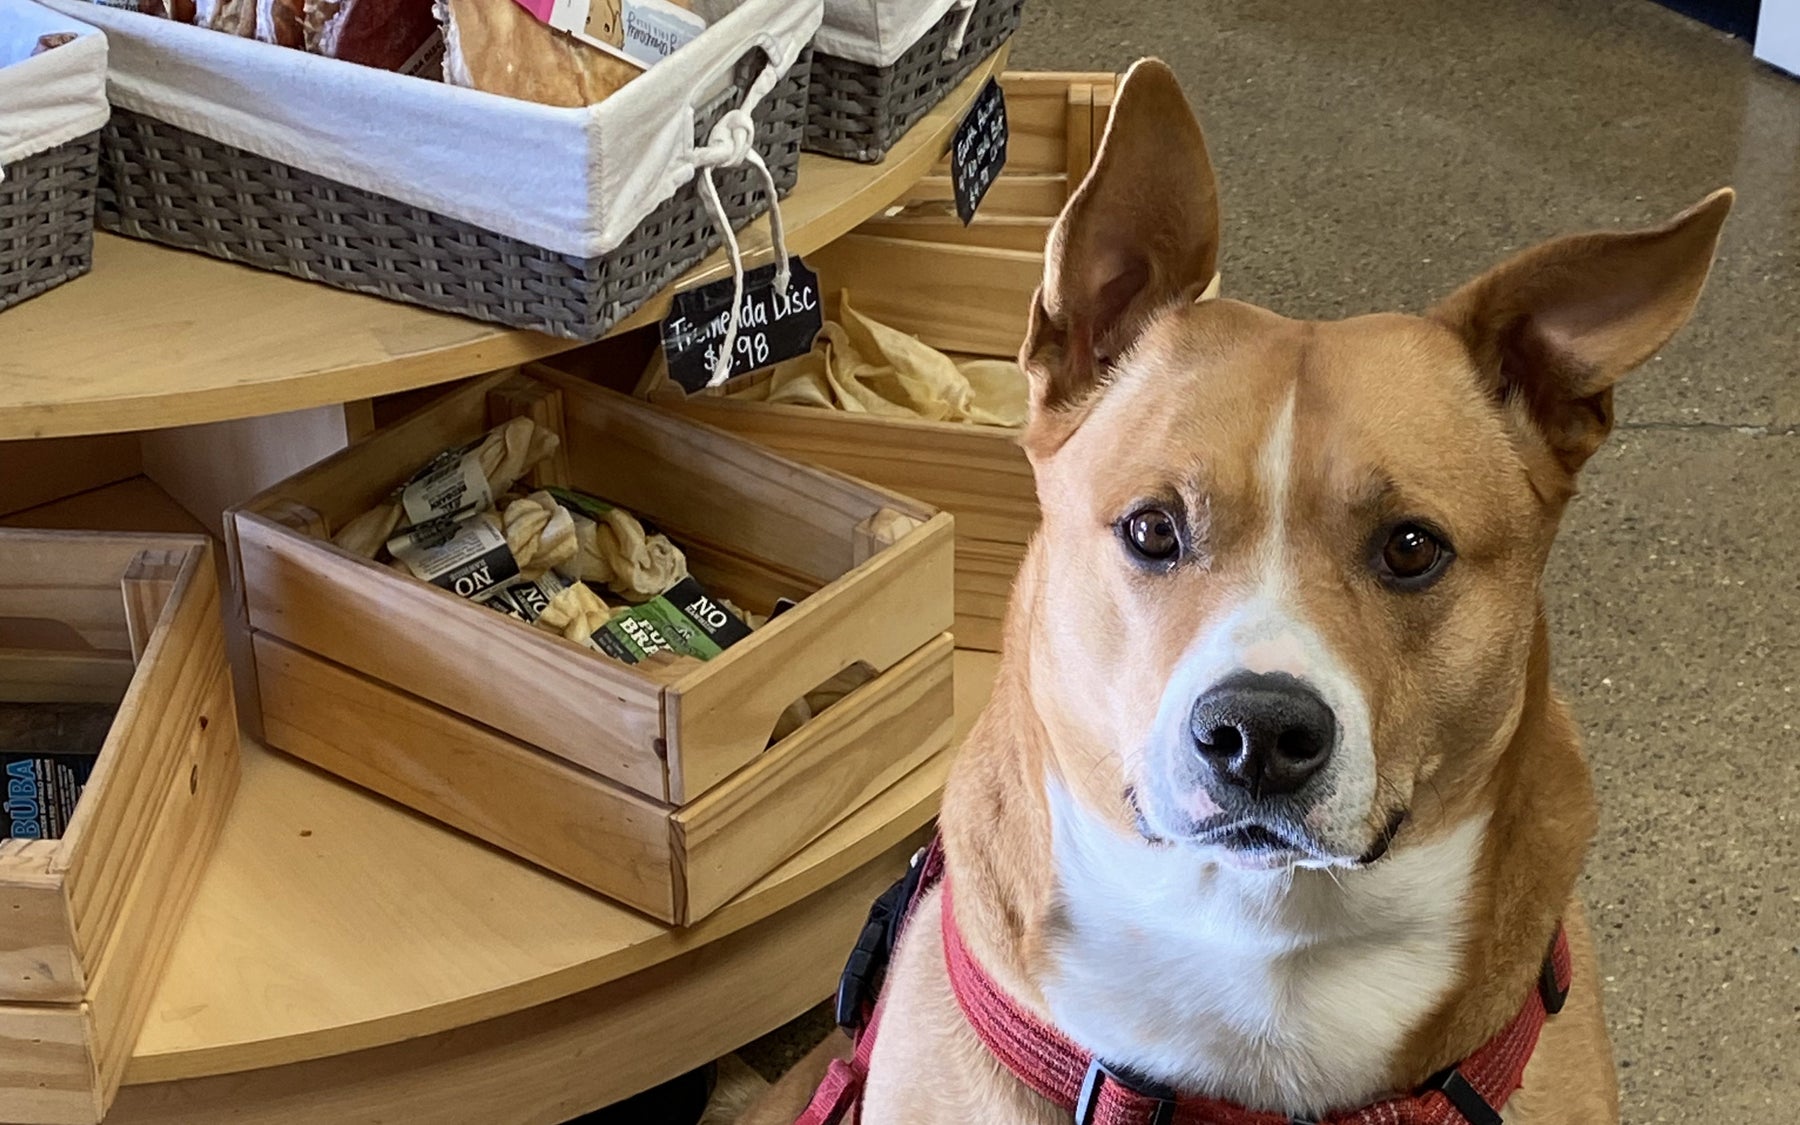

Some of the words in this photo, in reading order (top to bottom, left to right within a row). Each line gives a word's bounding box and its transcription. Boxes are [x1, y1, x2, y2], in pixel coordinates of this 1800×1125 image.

[771, 285, 817, 321] Disc
[455, 565, 494, 597] NO
[691, 595, 728, 629] NO
